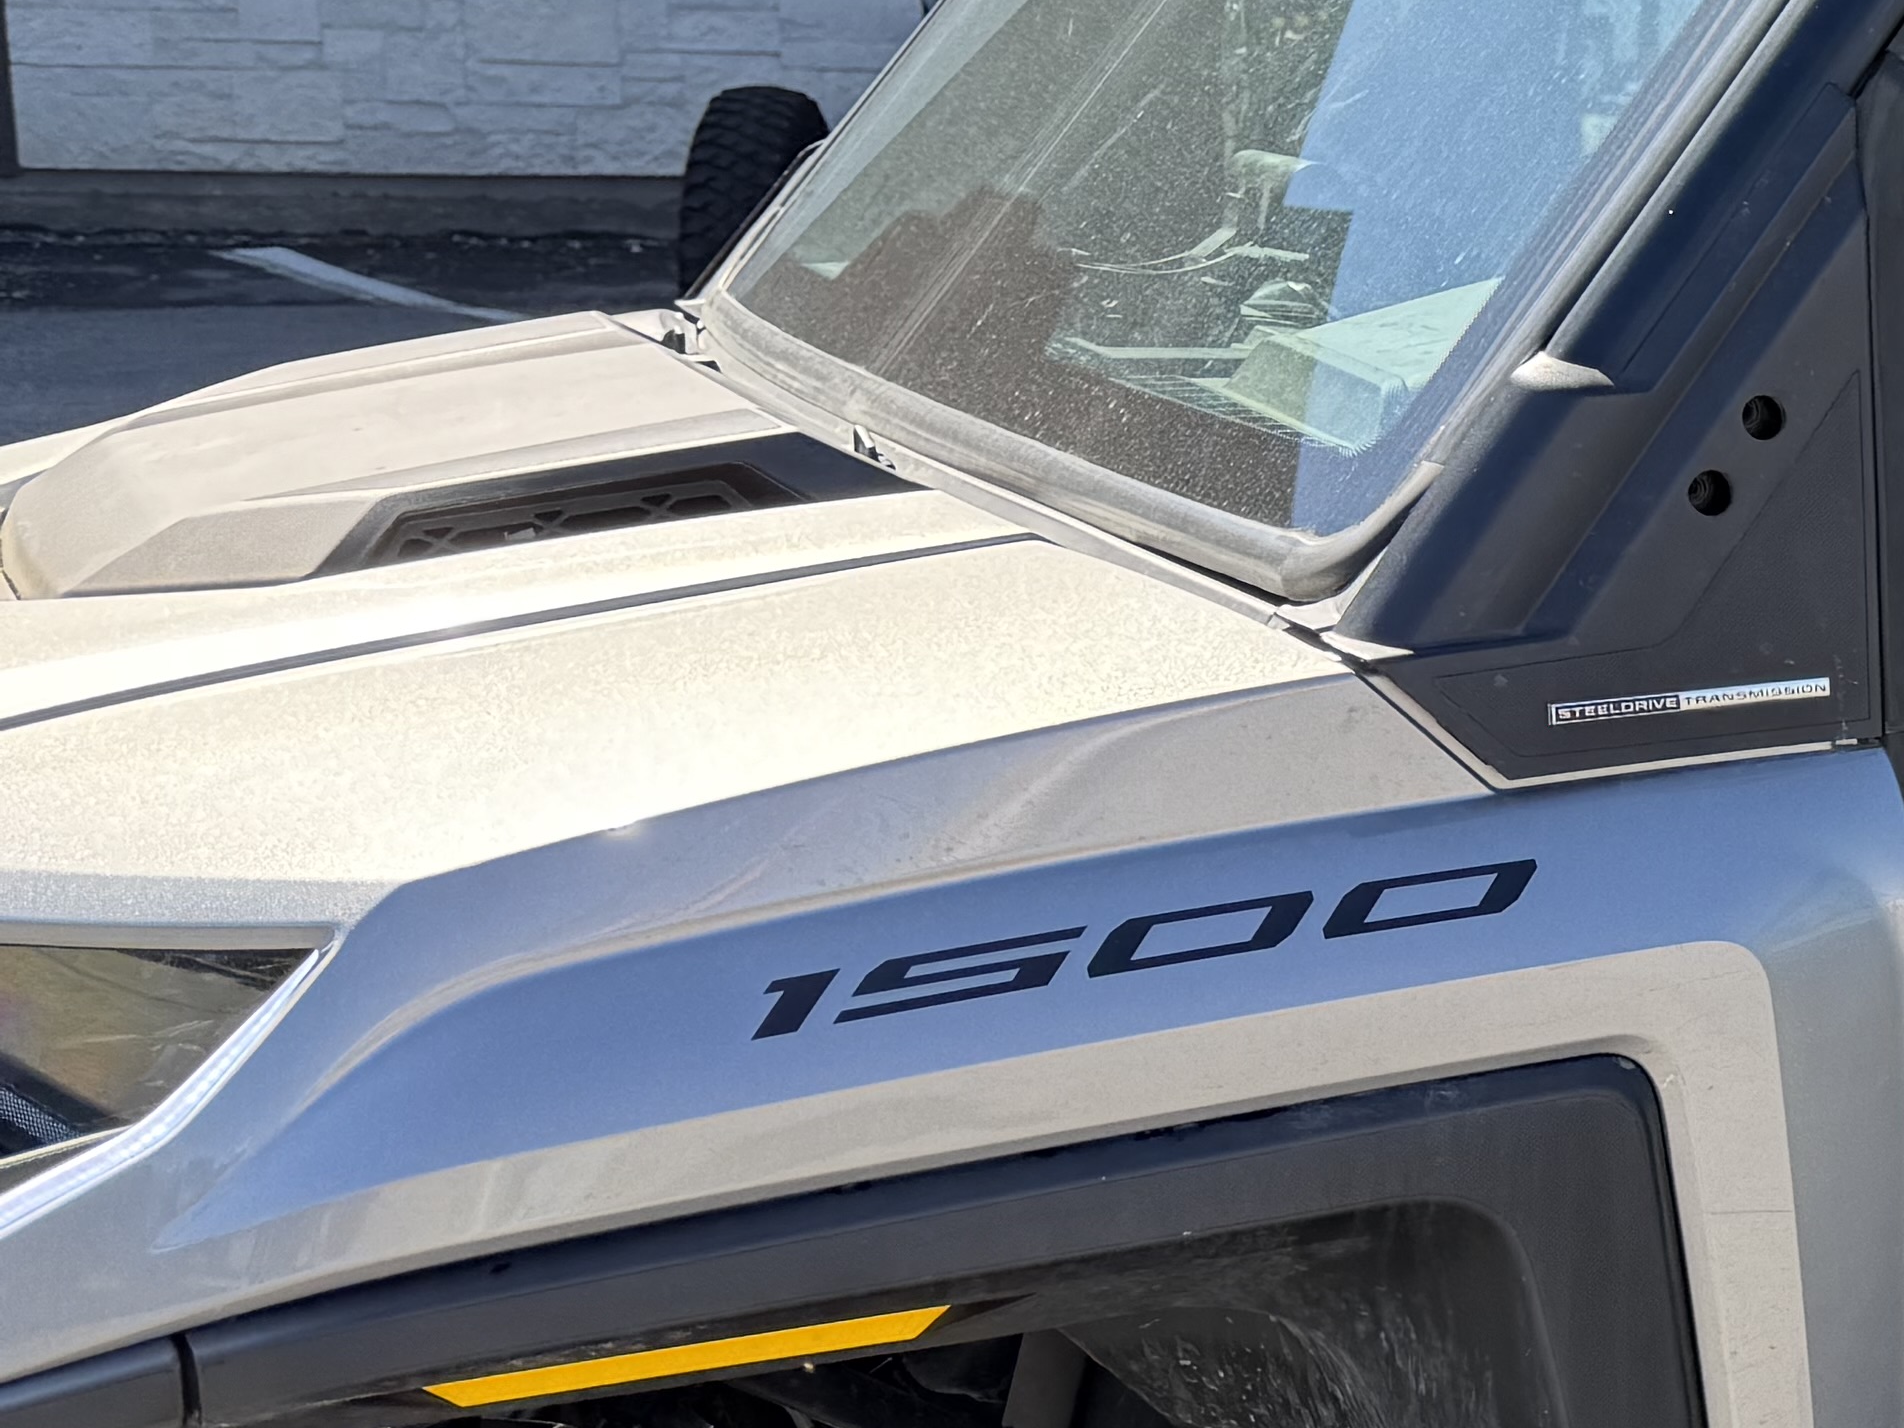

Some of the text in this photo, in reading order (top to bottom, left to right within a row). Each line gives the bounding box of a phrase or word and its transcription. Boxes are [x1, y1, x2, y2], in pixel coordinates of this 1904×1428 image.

[1557, 682, 1827, 720] STEELDRIVE TRANSMISSION
[750, 858, 1538, 1041] 1500
